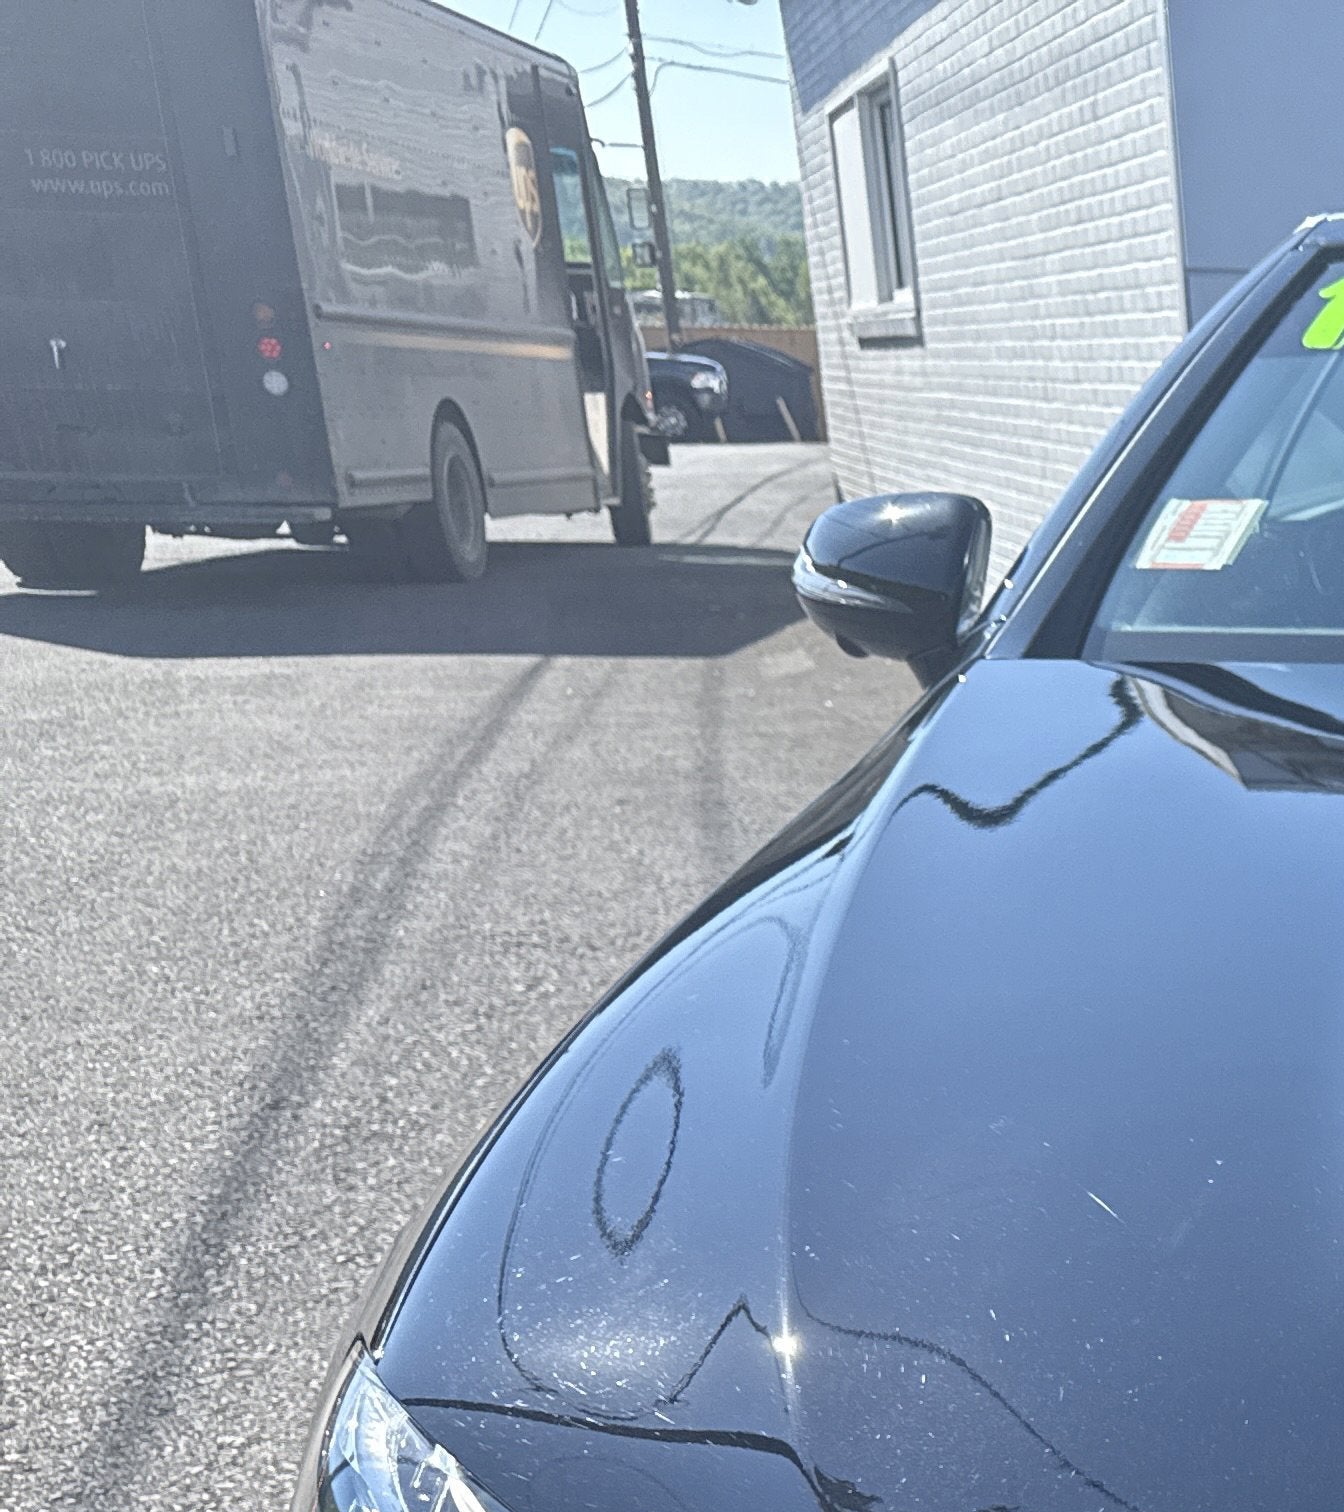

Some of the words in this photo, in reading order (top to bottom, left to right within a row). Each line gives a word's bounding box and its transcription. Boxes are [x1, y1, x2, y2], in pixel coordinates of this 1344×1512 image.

[40, 149, 76, 169] 800
[82, 150, 125, 173] PICK
[130, 152, 166, 173] UPS
[30, 177, 169, 199] www.ups.com
